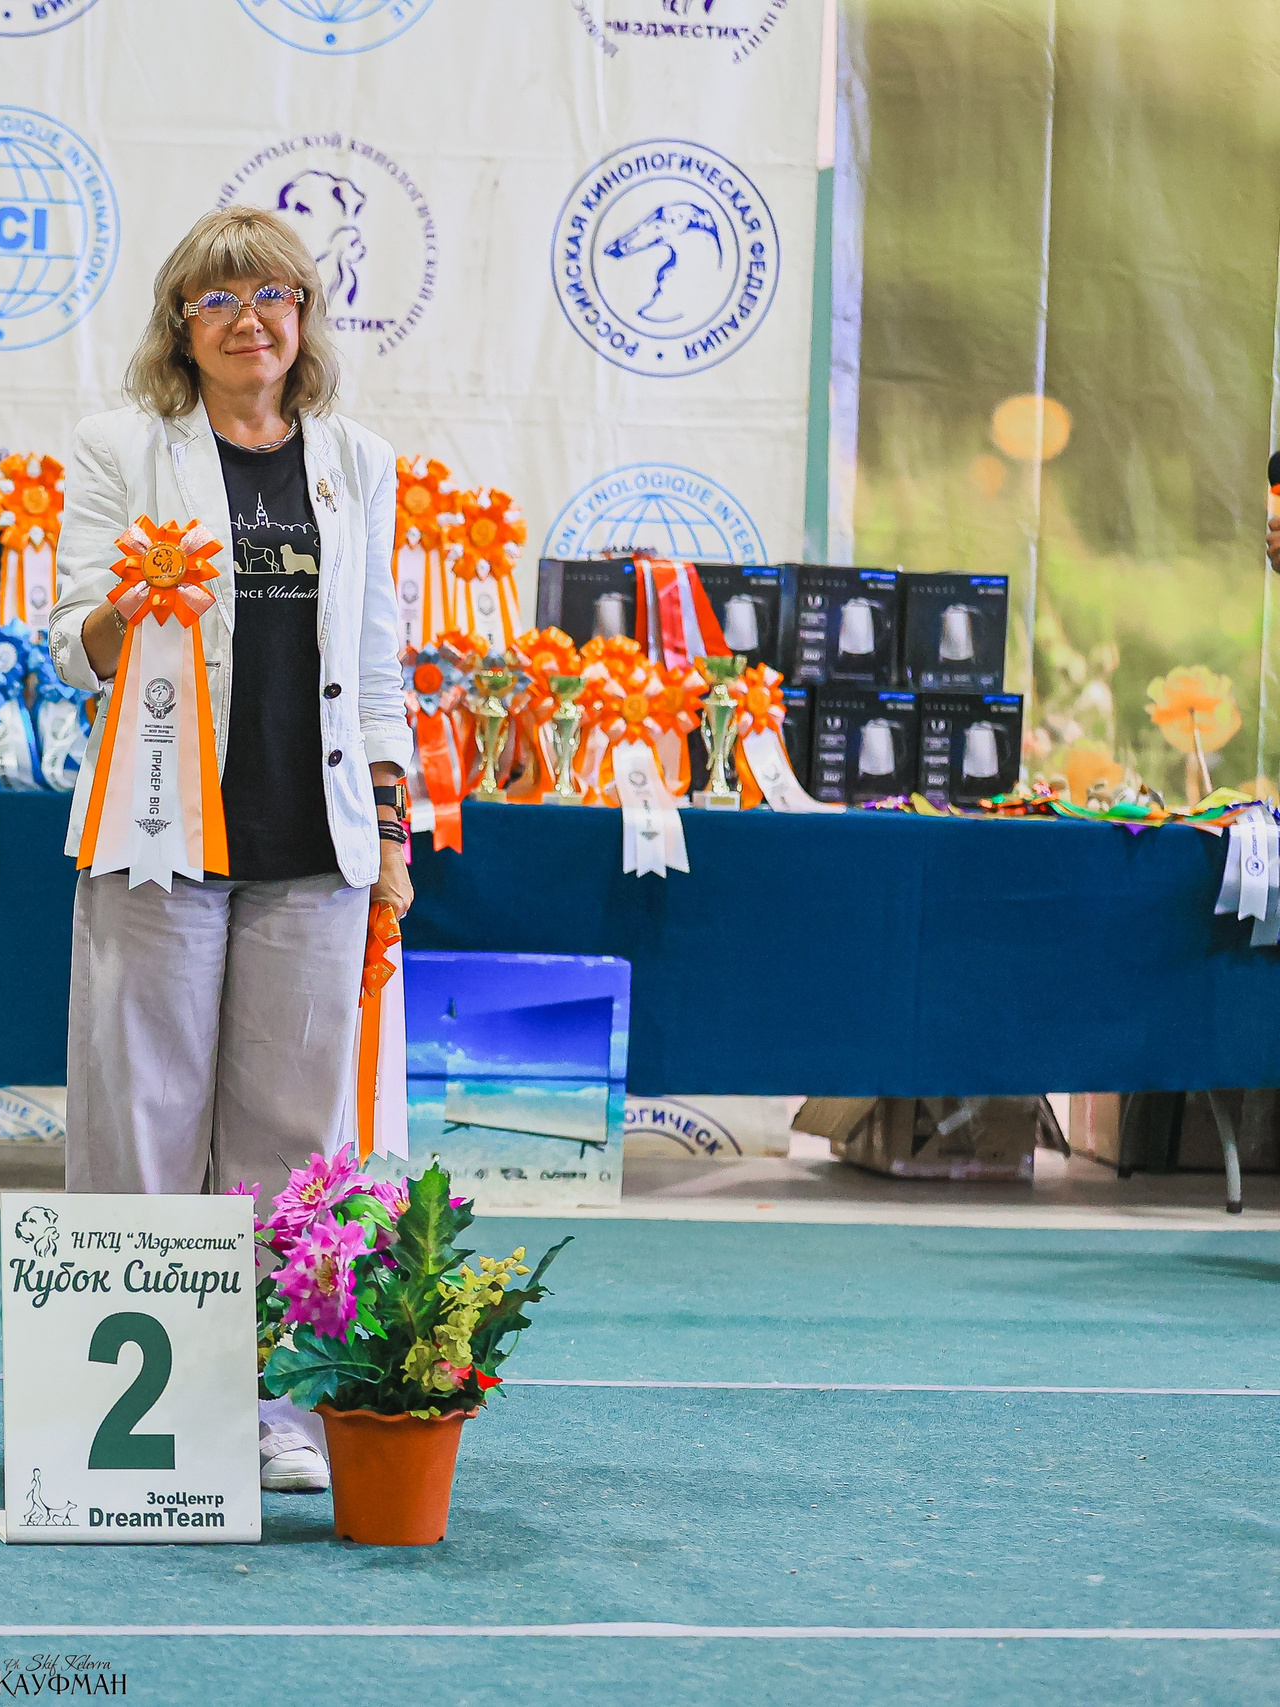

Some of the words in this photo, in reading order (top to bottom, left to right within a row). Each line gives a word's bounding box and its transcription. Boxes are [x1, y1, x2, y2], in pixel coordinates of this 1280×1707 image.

[581, 152, 762, 234] КИНОЛОГИЧЕСКАЯ
[57, 146, 110, 318] INTERNATIONALE
[565, 214, 639, 357] РОССИЙСКАЯ
[684, 241, 766, 361] ФЕДЕРАЦИЯ
[573, 472, 715, 526] CYNOLOGIQUE
[150, 750, 163, 792] ПРИЗЁР
[149, 797, 160, 815] BIG
[71, 1231, 121, 1253] НГКЦ
[9, 1258, 111, 1309] Кубок
[123, 1259, 242, 1309] Сибири
[87, 1311, 176, 1470] 2
[89, 1507, 225, 1527] DreamTeam
[146, 1491, 224, 1508] ЗооЦентр
